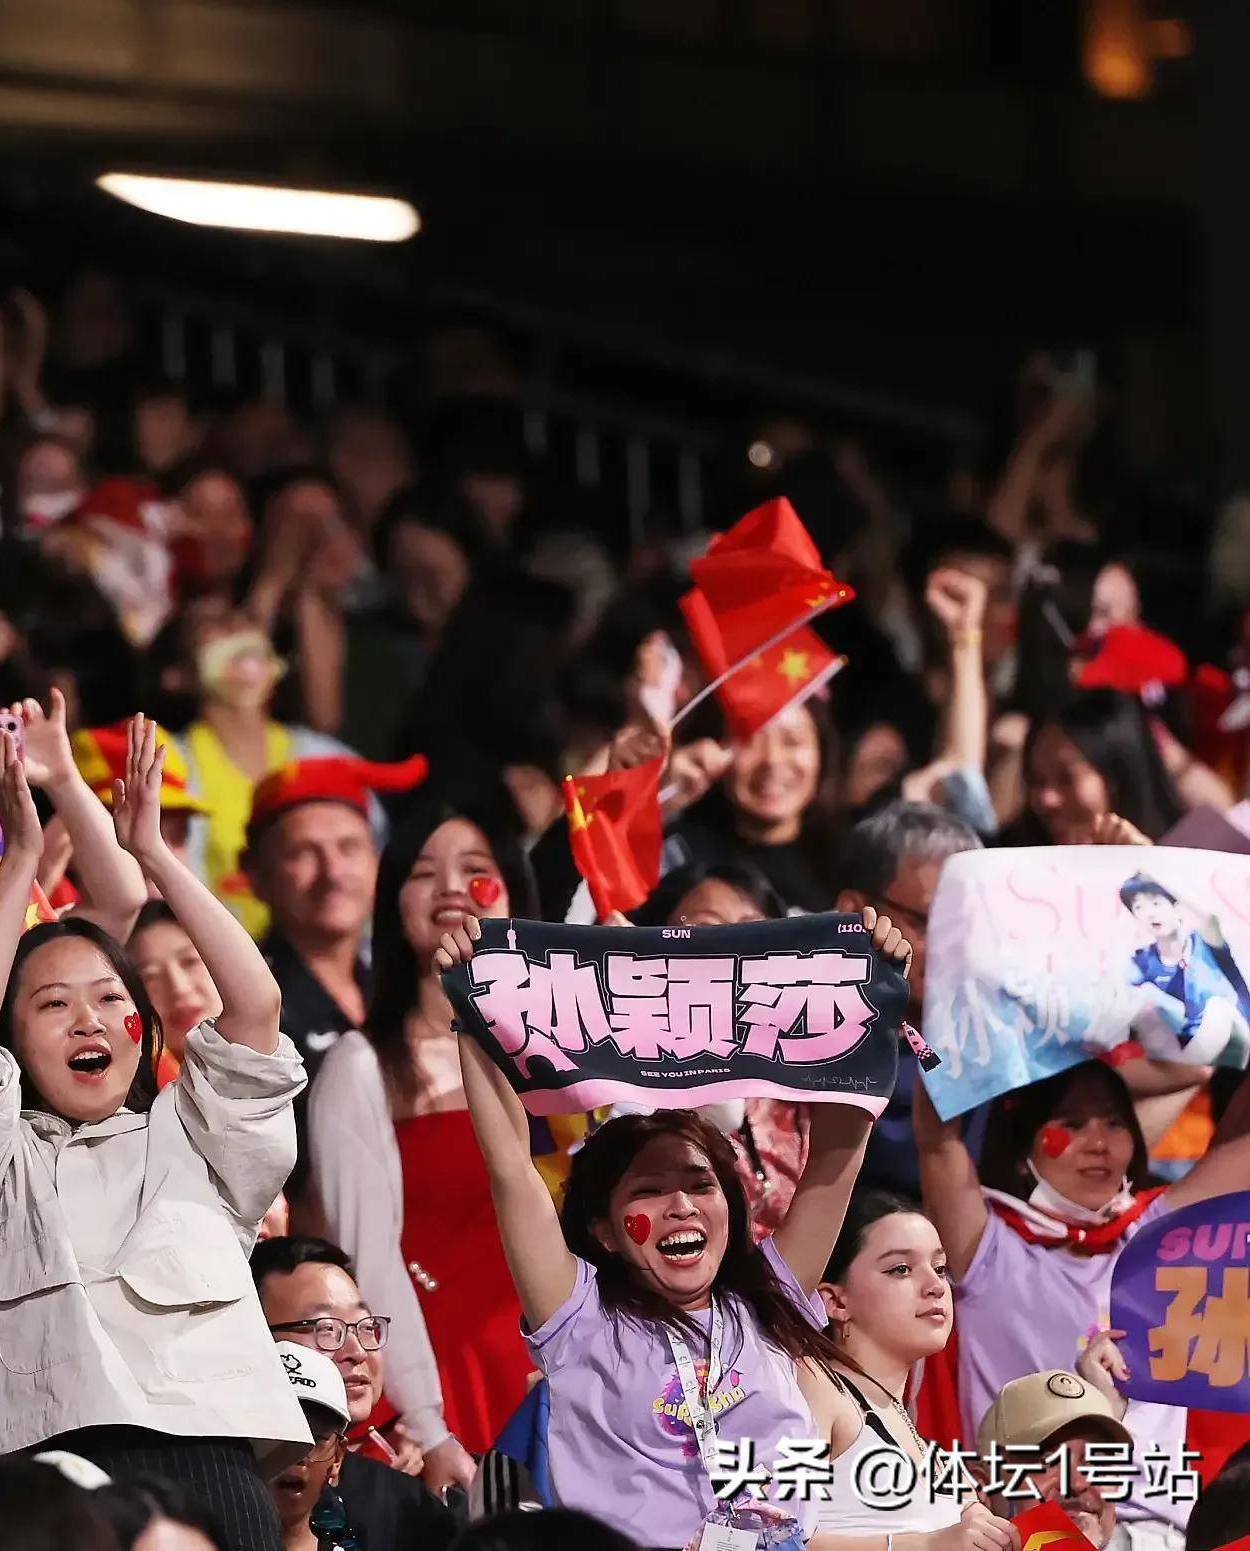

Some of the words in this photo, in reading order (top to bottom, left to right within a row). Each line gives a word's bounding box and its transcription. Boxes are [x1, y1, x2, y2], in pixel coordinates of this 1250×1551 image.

[661, 929, 691, 939] SUN
[470, 951, 877, 1066] 孙颖莎
[1148, 1266, 1250, 1388] 孙
